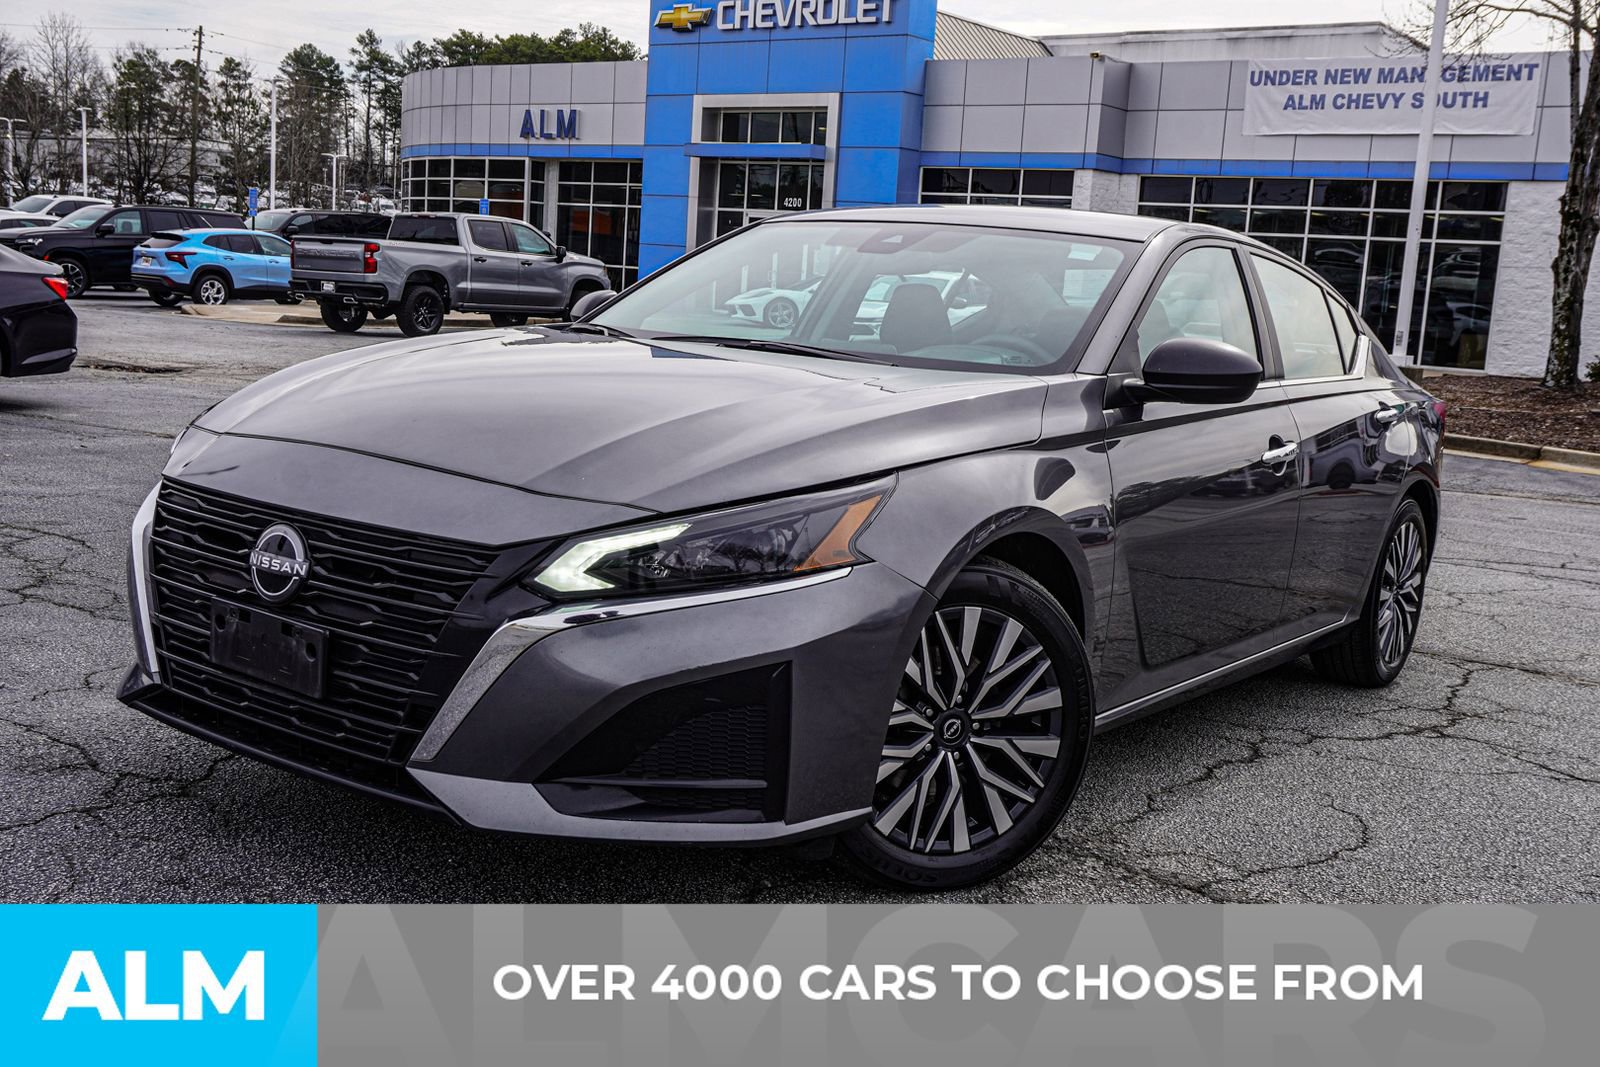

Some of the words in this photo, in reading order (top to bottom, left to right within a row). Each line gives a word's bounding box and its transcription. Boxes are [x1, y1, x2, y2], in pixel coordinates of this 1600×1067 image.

[716, 0, 892, 30] CHEVROLET
[1250, 69, 1318, 87] UNDER
[1324, 67, 1372, 85] NEW
[1376, 63, 1540, 84] MANGEMENT
[1283, 94, 1327, 110] ALM
[1332, 92, 1405, 110] CHEVY
[520, 109, 578, 139] ALM
[783, 197, 802, 208] 4200
[249, 551, 307, 576] NISSAN
